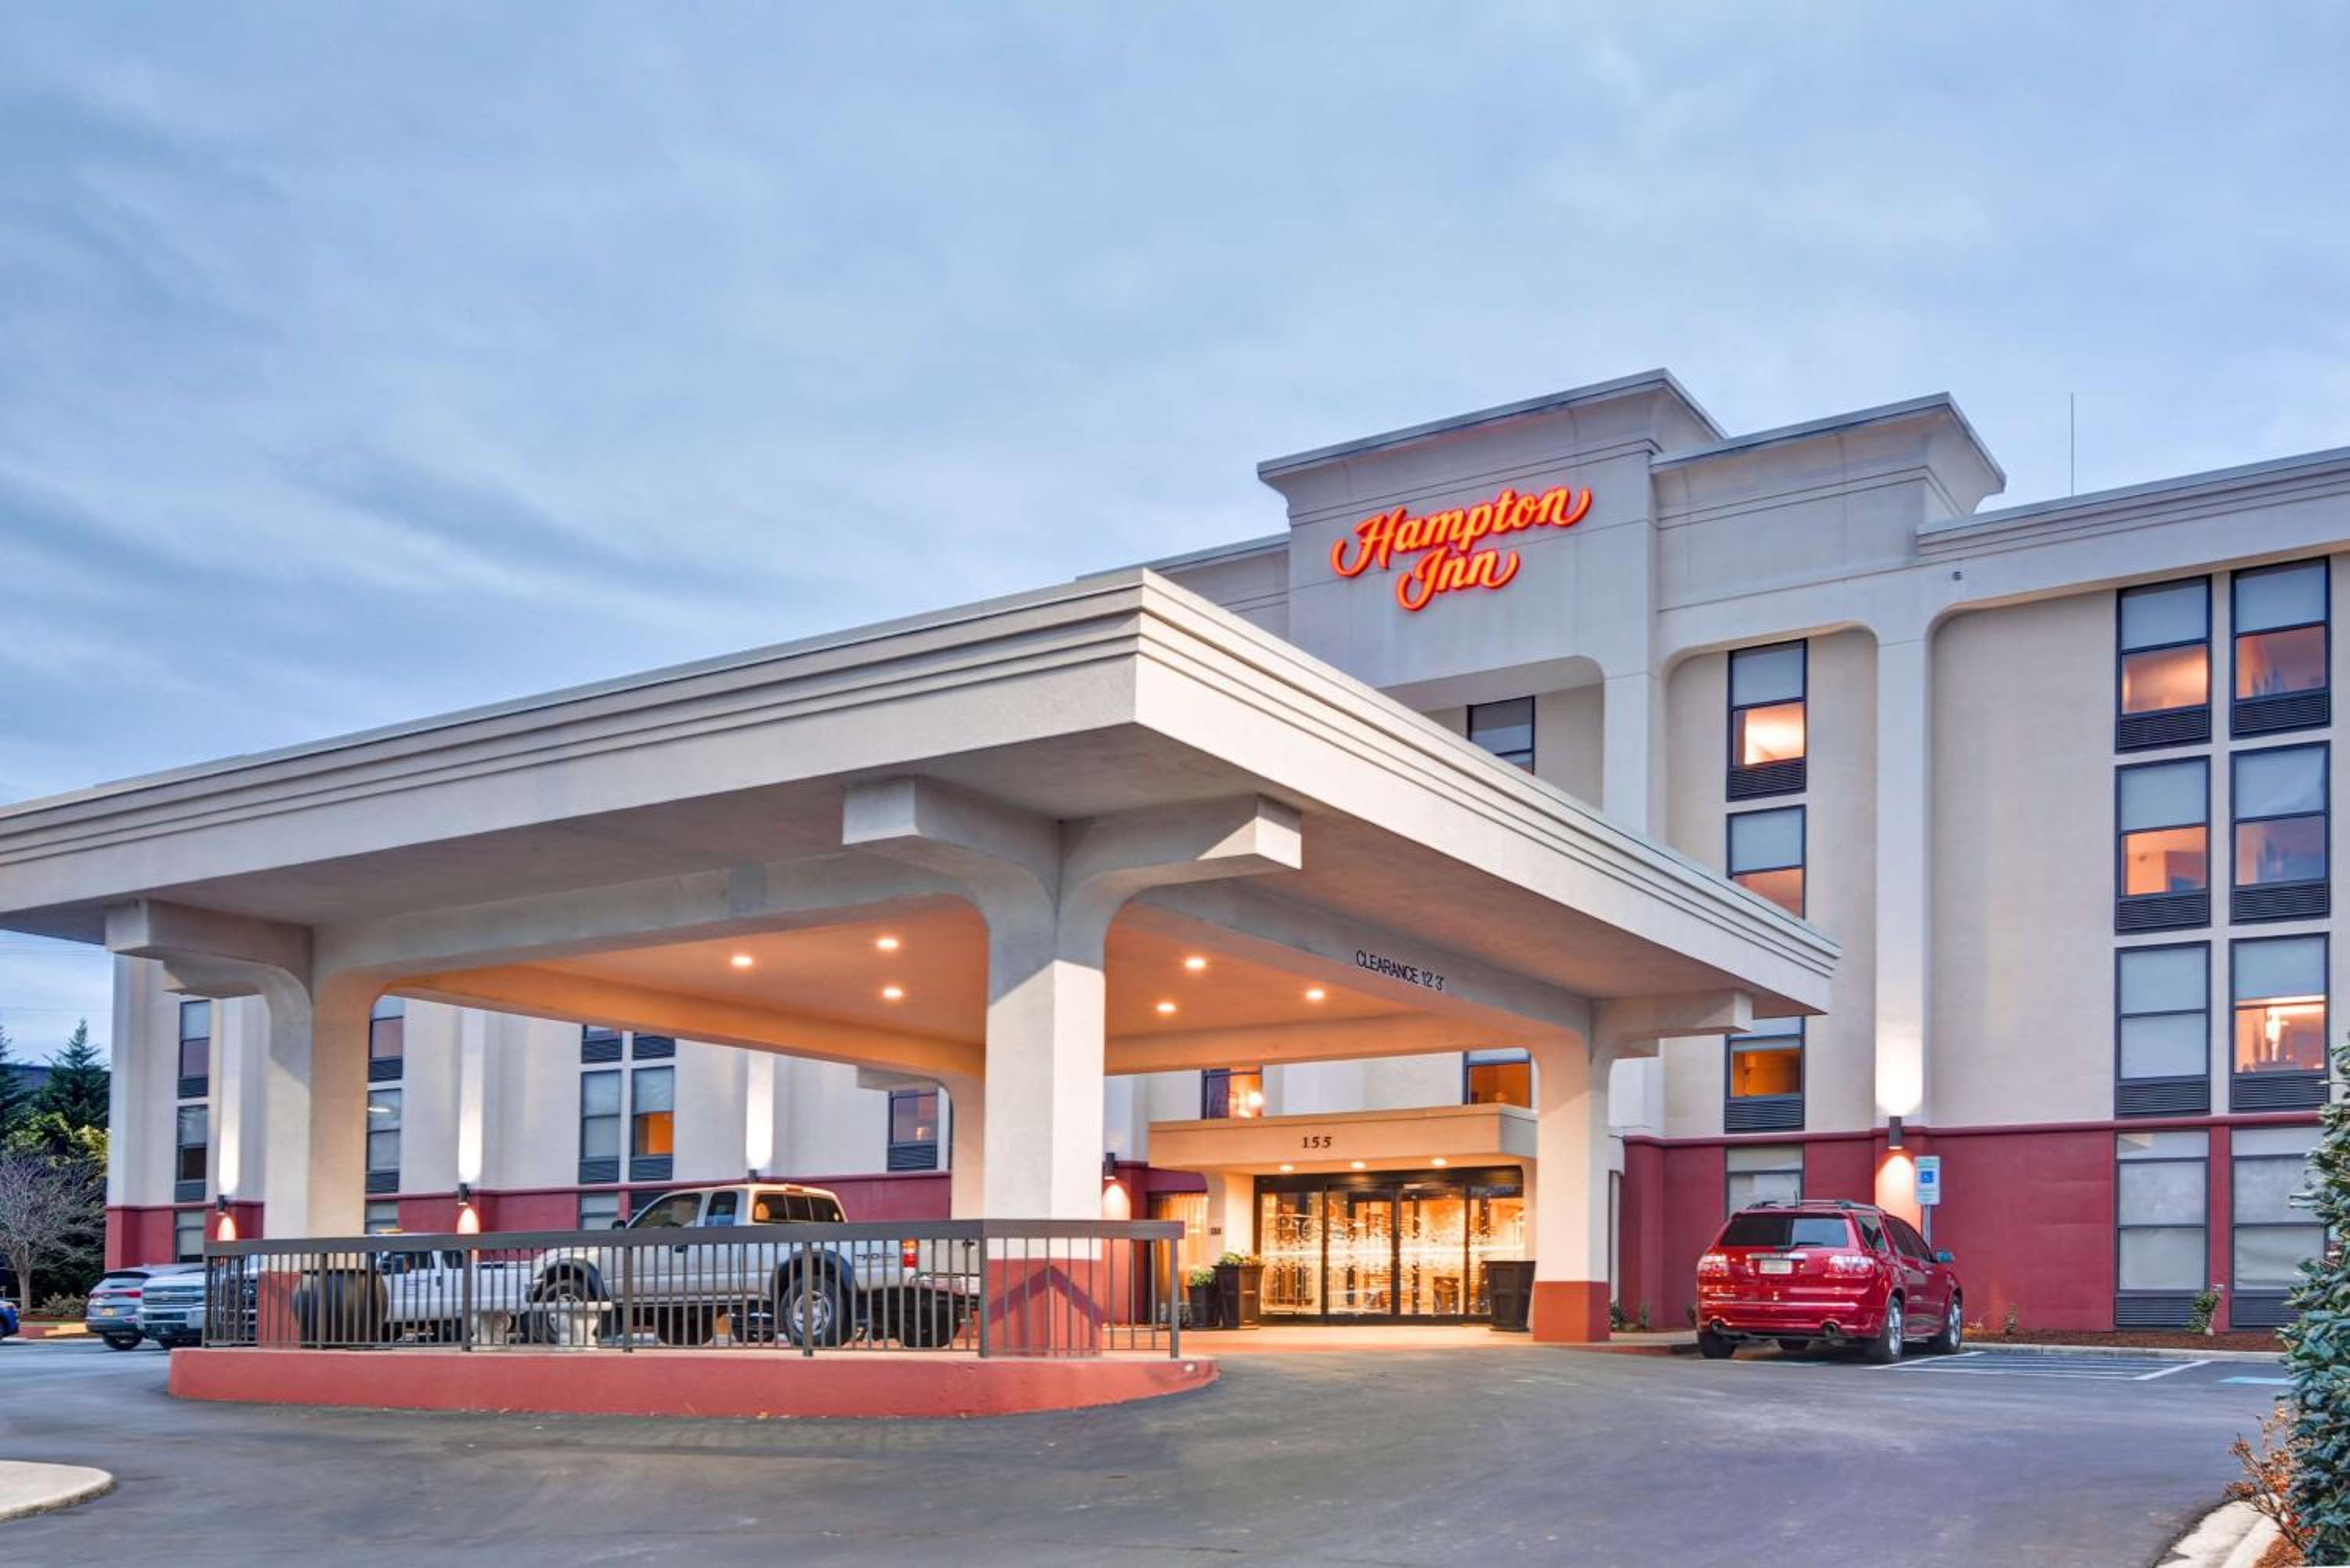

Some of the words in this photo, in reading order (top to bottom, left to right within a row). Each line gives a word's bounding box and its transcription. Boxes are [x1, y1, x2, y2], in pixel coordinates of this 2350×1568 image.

[1331, 487, 1592, 577] Hampton
[1396, 547, 1520, 612] Inn
[1356, 950, 1418, 984] CLEARANCE
[1303, 1136, 1332, 1148] 155
